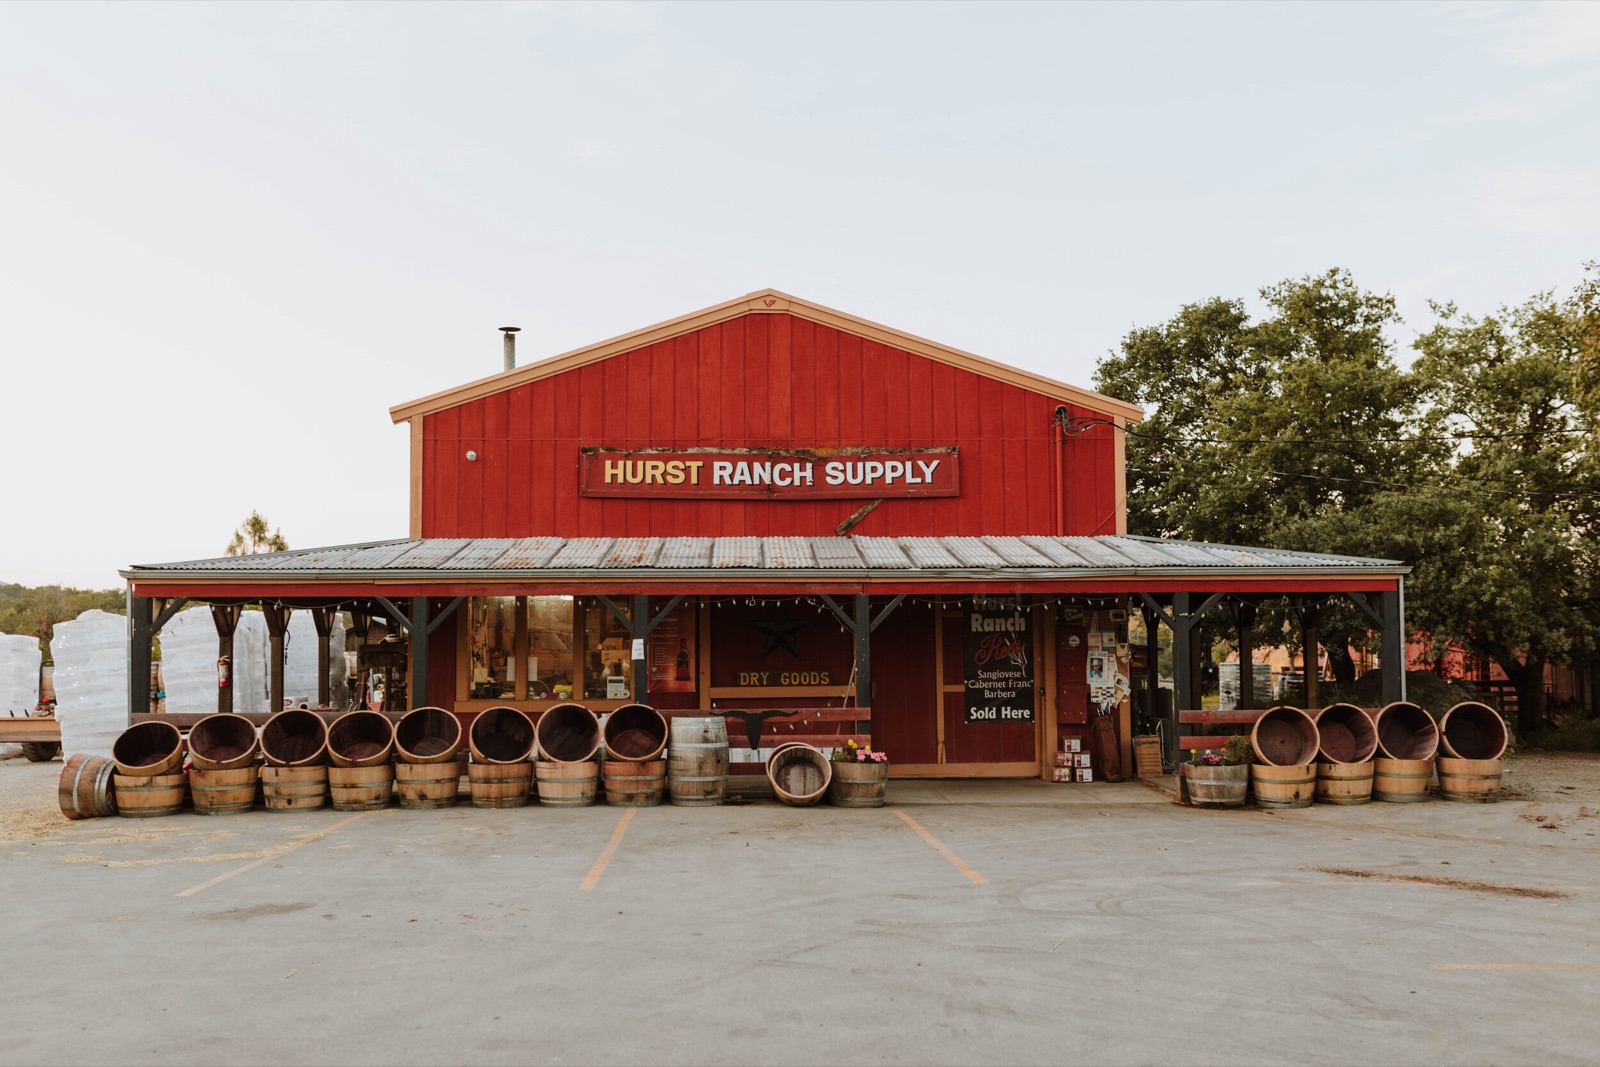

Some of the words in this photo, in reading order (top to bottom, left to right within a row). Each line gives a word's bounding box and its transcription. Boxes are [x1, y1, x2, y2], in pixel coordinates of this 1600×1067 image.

[604, 460, 703, 485] HURST
[713, 461, 813, 486] RANCH
[825, 460, 940, 485] SUPPLY
[971, 612, 1026, 632] Ranch
[740, 672, 770, 686] DRY
[781, 672, 830, 686] GOODS
[978, 670, 1022, 680] Sangiovese
[968, 680, 1006, 689] Cabernet
[1009, 680, 1032, 689] Franc
[984, 690, 1016, 698] Barbera
[970, 707, 997, 719] Sold
[1001, 707, 1031, 719] Here
